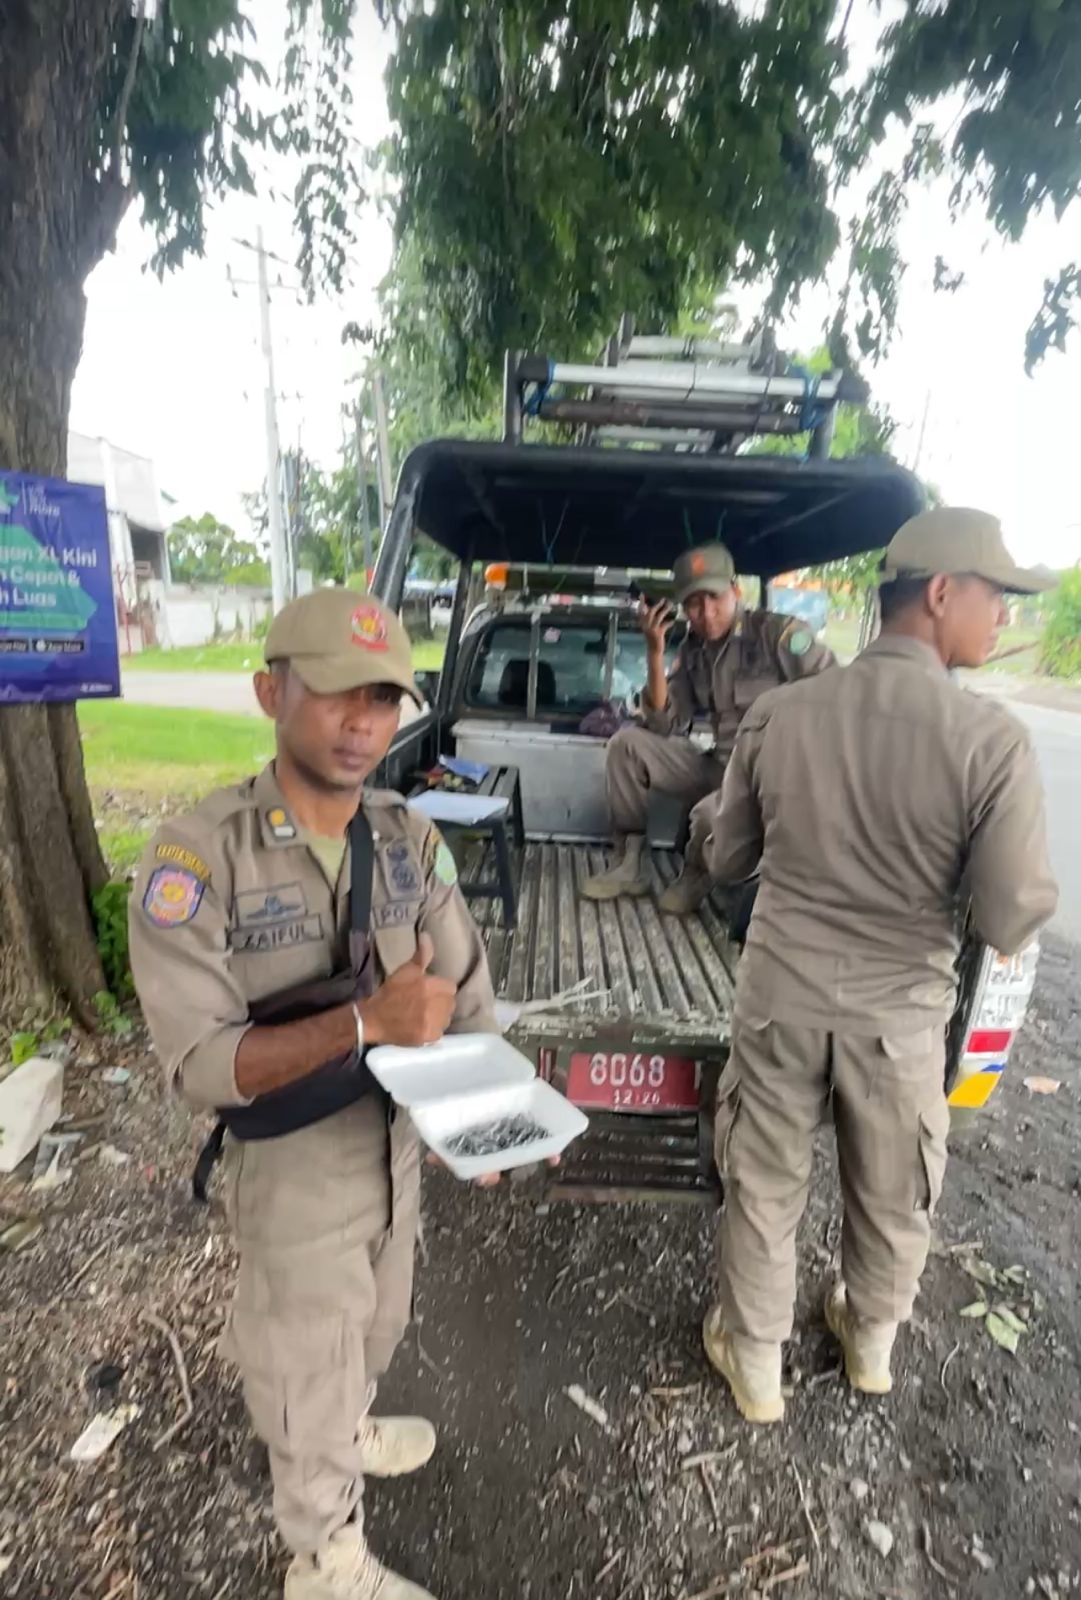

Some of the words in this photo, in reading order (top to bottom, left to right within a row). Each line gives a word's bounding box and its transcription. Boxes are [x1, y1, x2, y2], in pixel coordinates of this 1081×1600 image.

[63, 546, 97, 568] Kini
[13, 587, 57, 607] Luas
[590, 1052, 665, 1087] 8068
